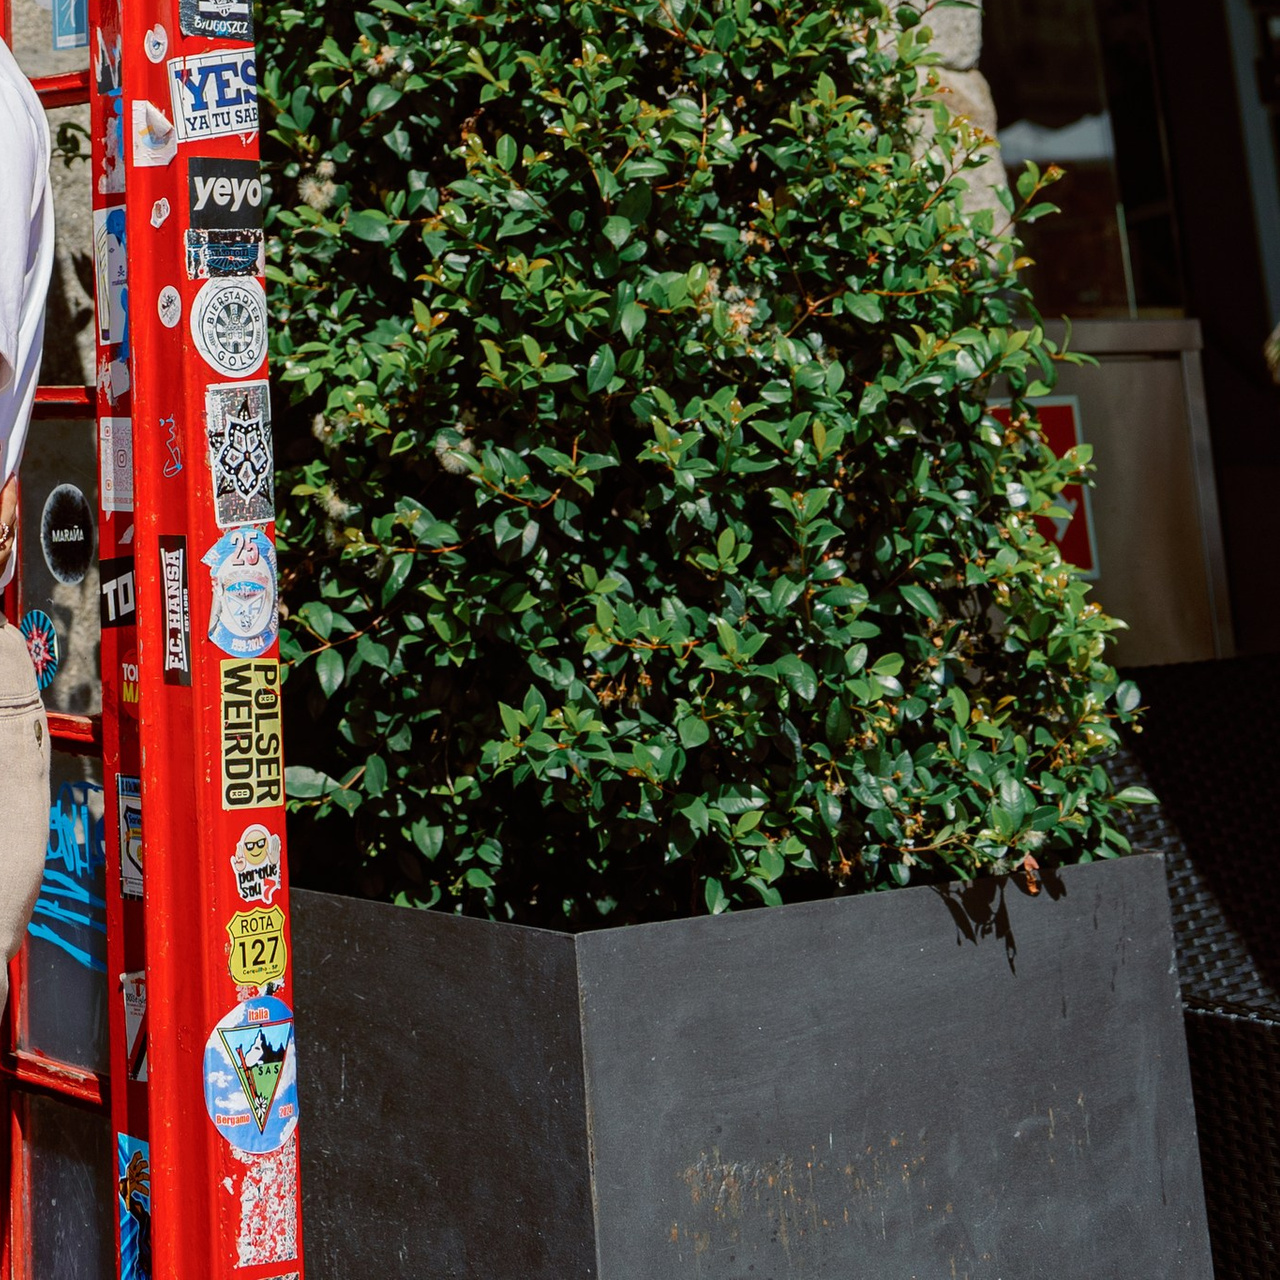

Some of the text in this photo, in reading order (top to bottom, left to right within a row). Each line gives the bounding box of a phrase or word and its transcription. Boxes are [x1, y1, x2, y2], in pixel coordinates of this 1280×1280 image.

[174, 59, 257, 113] YES
[185, 114, 210, 132] YA
[212, 111, 231, 127] TU
[192, 175, 262, 212] yeyo
[217, 349, 256, 366] GOLD
[51, 524, 85, 544] MARAÑA
[230, 532, 260, 567] 25
[166, 550, 184, 671] F.C. HANSA
[222, 662, 255, 806] WEIRDO
[240, 915, 274, 935] ROTA
[238, 935, 279, 969] 127
[216, 1112, 250, 1126] Bergamo
